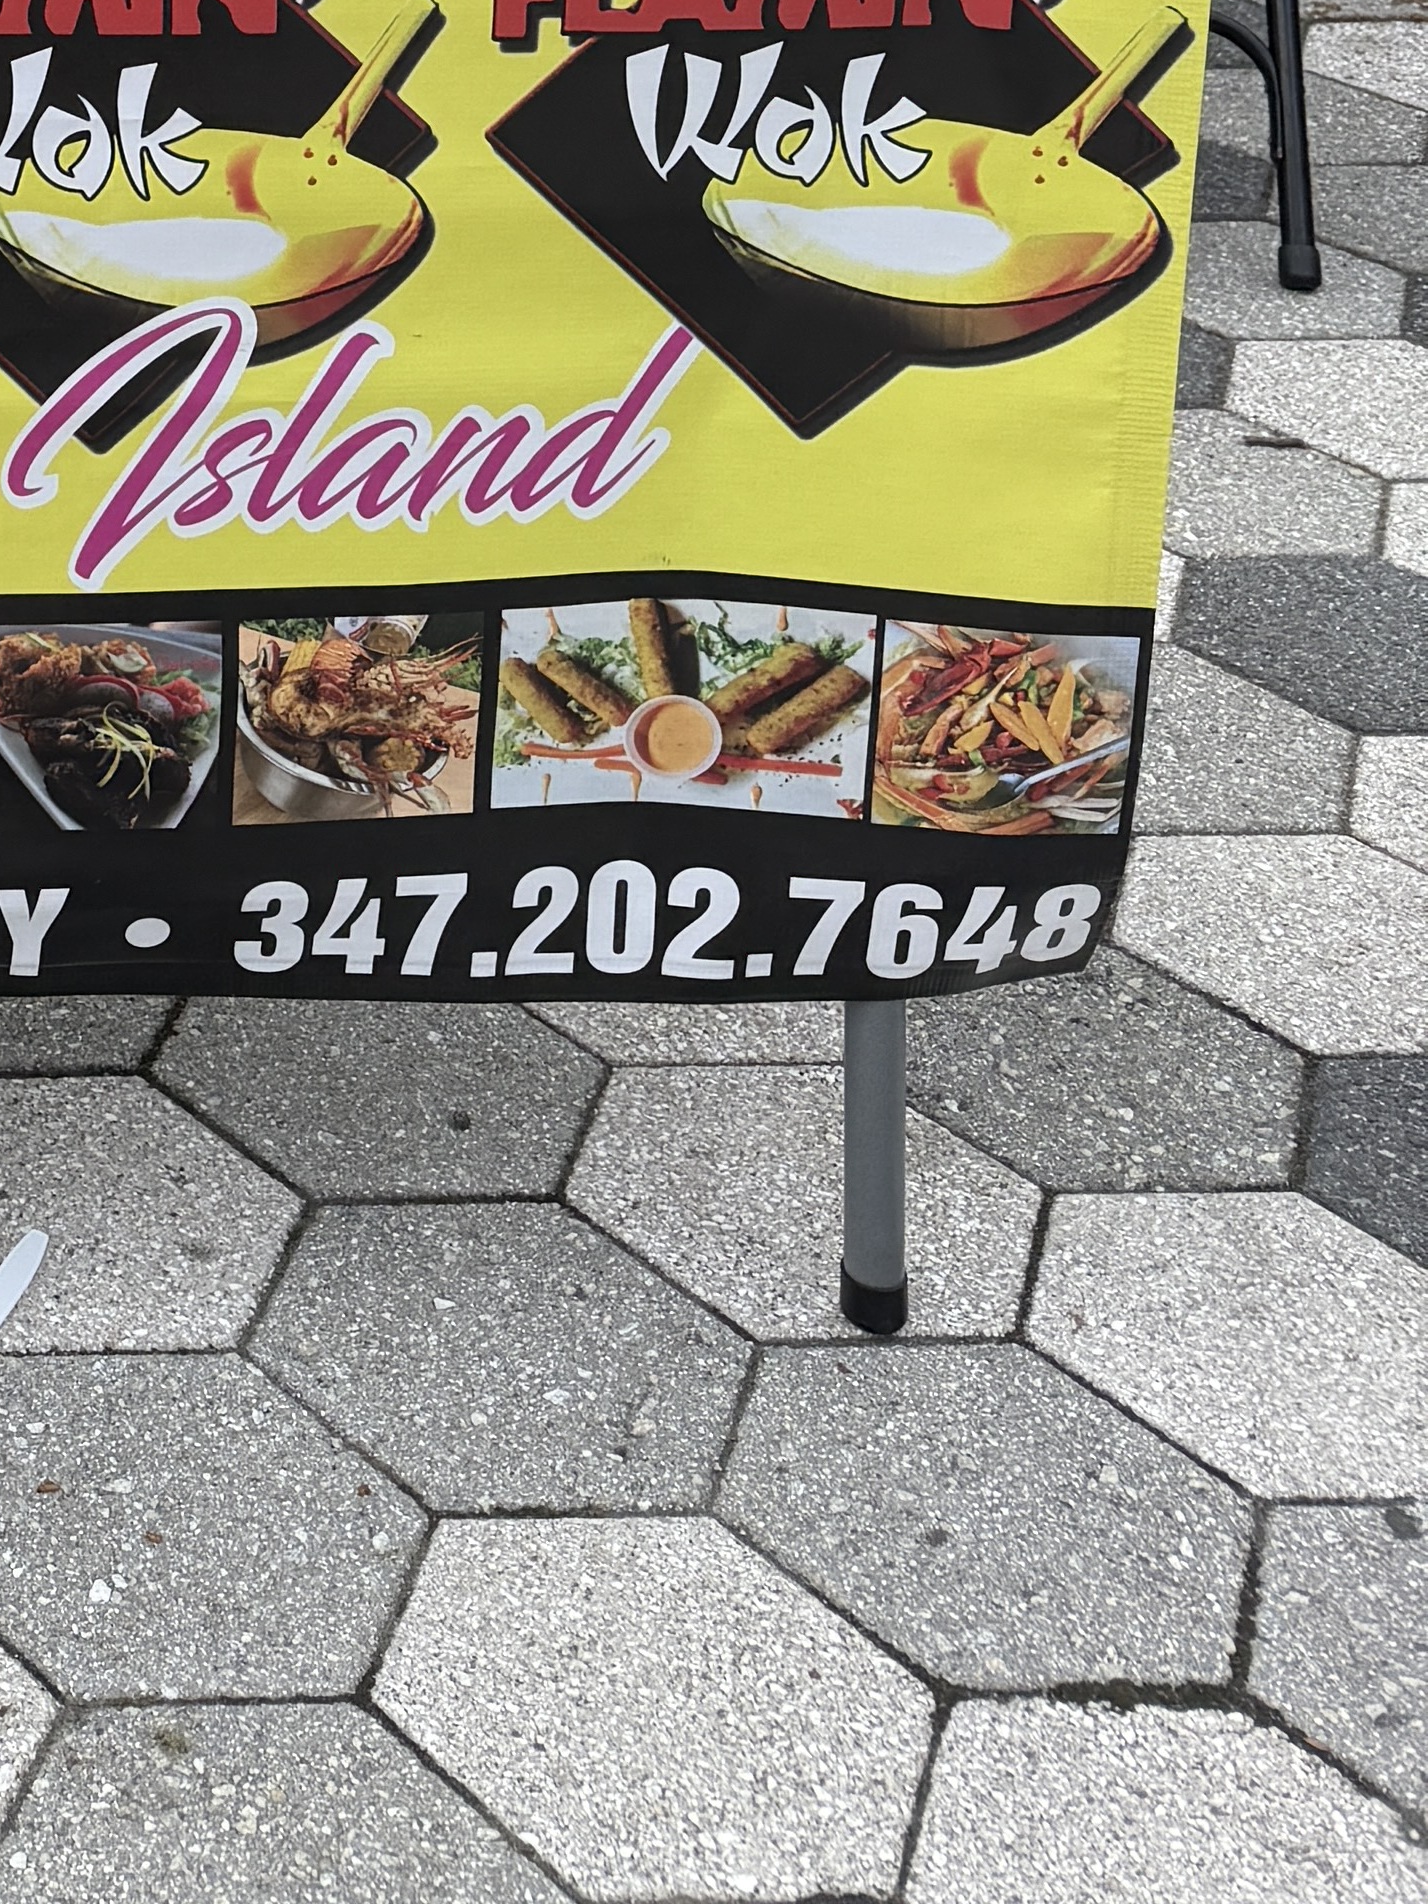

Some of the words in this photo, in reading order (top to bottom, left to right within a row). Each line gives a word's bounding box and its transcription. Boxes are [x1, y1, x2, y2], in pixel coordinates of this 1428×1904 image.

[625, 39, 934, 188] Wok
[5, 300, 706, 590] Island
[231, 857, 1104, 982] 347.202.7648
